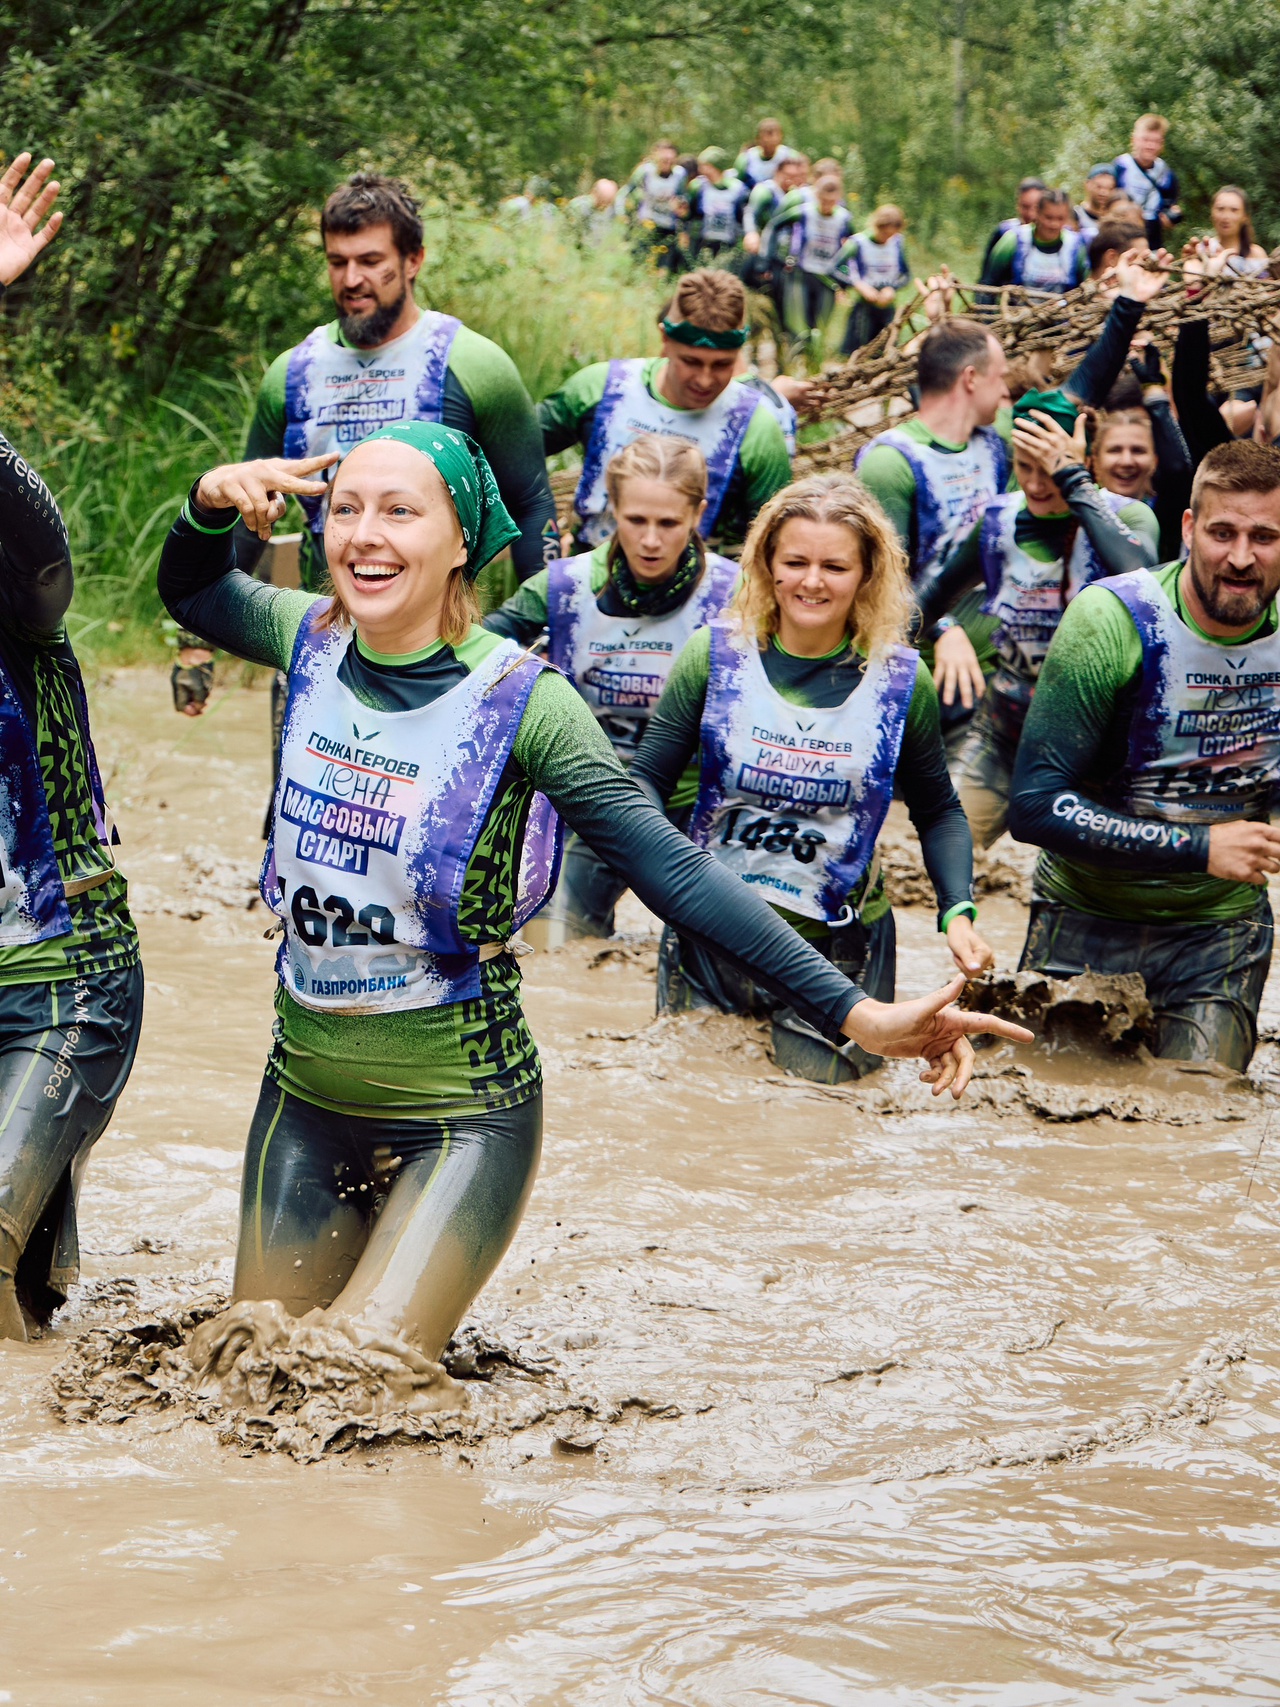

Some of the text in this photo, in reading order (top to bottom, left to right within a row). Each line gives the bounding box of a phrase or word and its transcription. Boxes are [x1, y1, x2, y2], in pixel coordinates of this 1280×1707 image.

[588, 640, 673, 652] ГОНКА ГЕРОЕВ
[1186, 673, 1232, 685] ГОНКА
[307, 731, 420, 778] ГОНКА ГЕРОЕВ
[752, 726, 853, 753] ГОНКА ГЕРОЕВ
[741, 768, 847, 803] МАССОВЫЙ
[283, 786, 399, 848] МАССОВЫЙ
[1052, 793, 1173, 848] Greenway
[299, 830, 365, 871] СТАРТ
[736, 873, 802, 897] ЗПРОМБАНК
[311, 975, 407, 995] ГАЗПРОМБАНК
